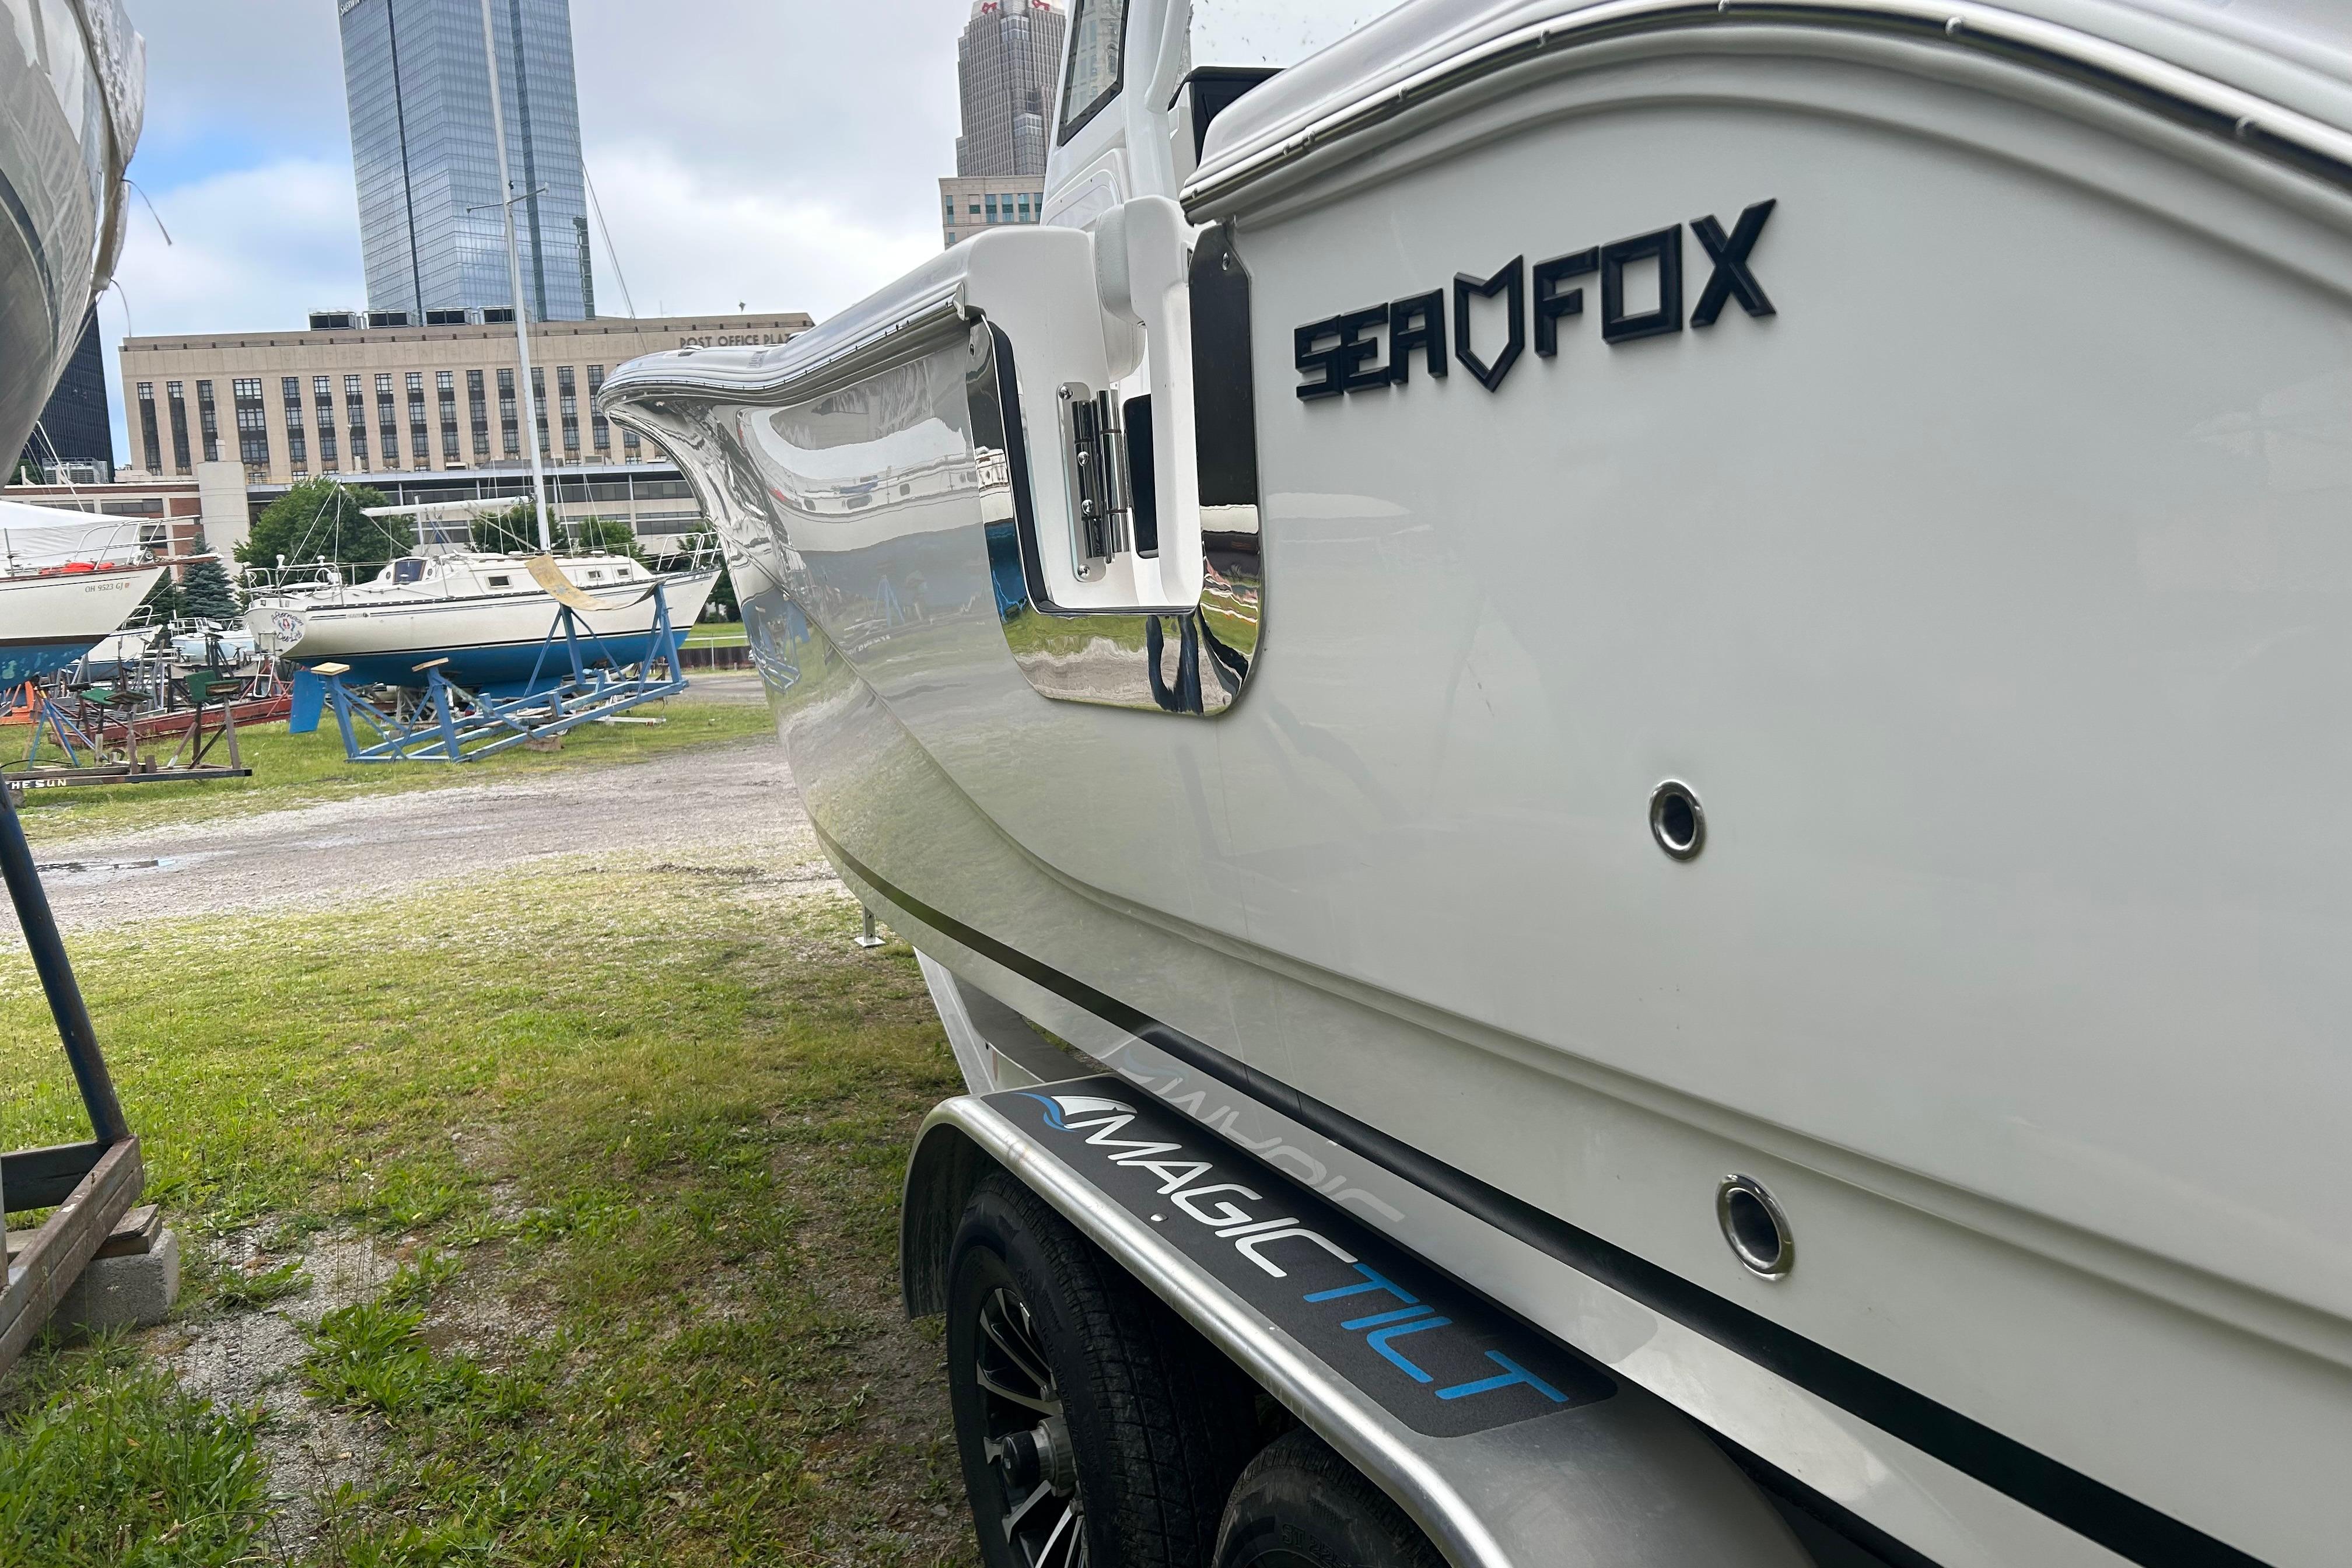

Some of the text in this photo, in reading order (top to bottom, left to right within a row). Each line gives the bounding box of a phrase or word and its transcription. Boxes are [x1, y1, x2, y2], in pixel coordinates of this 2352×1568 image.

[1294, 198, 1777, 401] SEA FOX
[680, 336, 712, 348] POST
[718, 334, 758, 346] OFFICE
[35, 779, 66, 788] SUN
